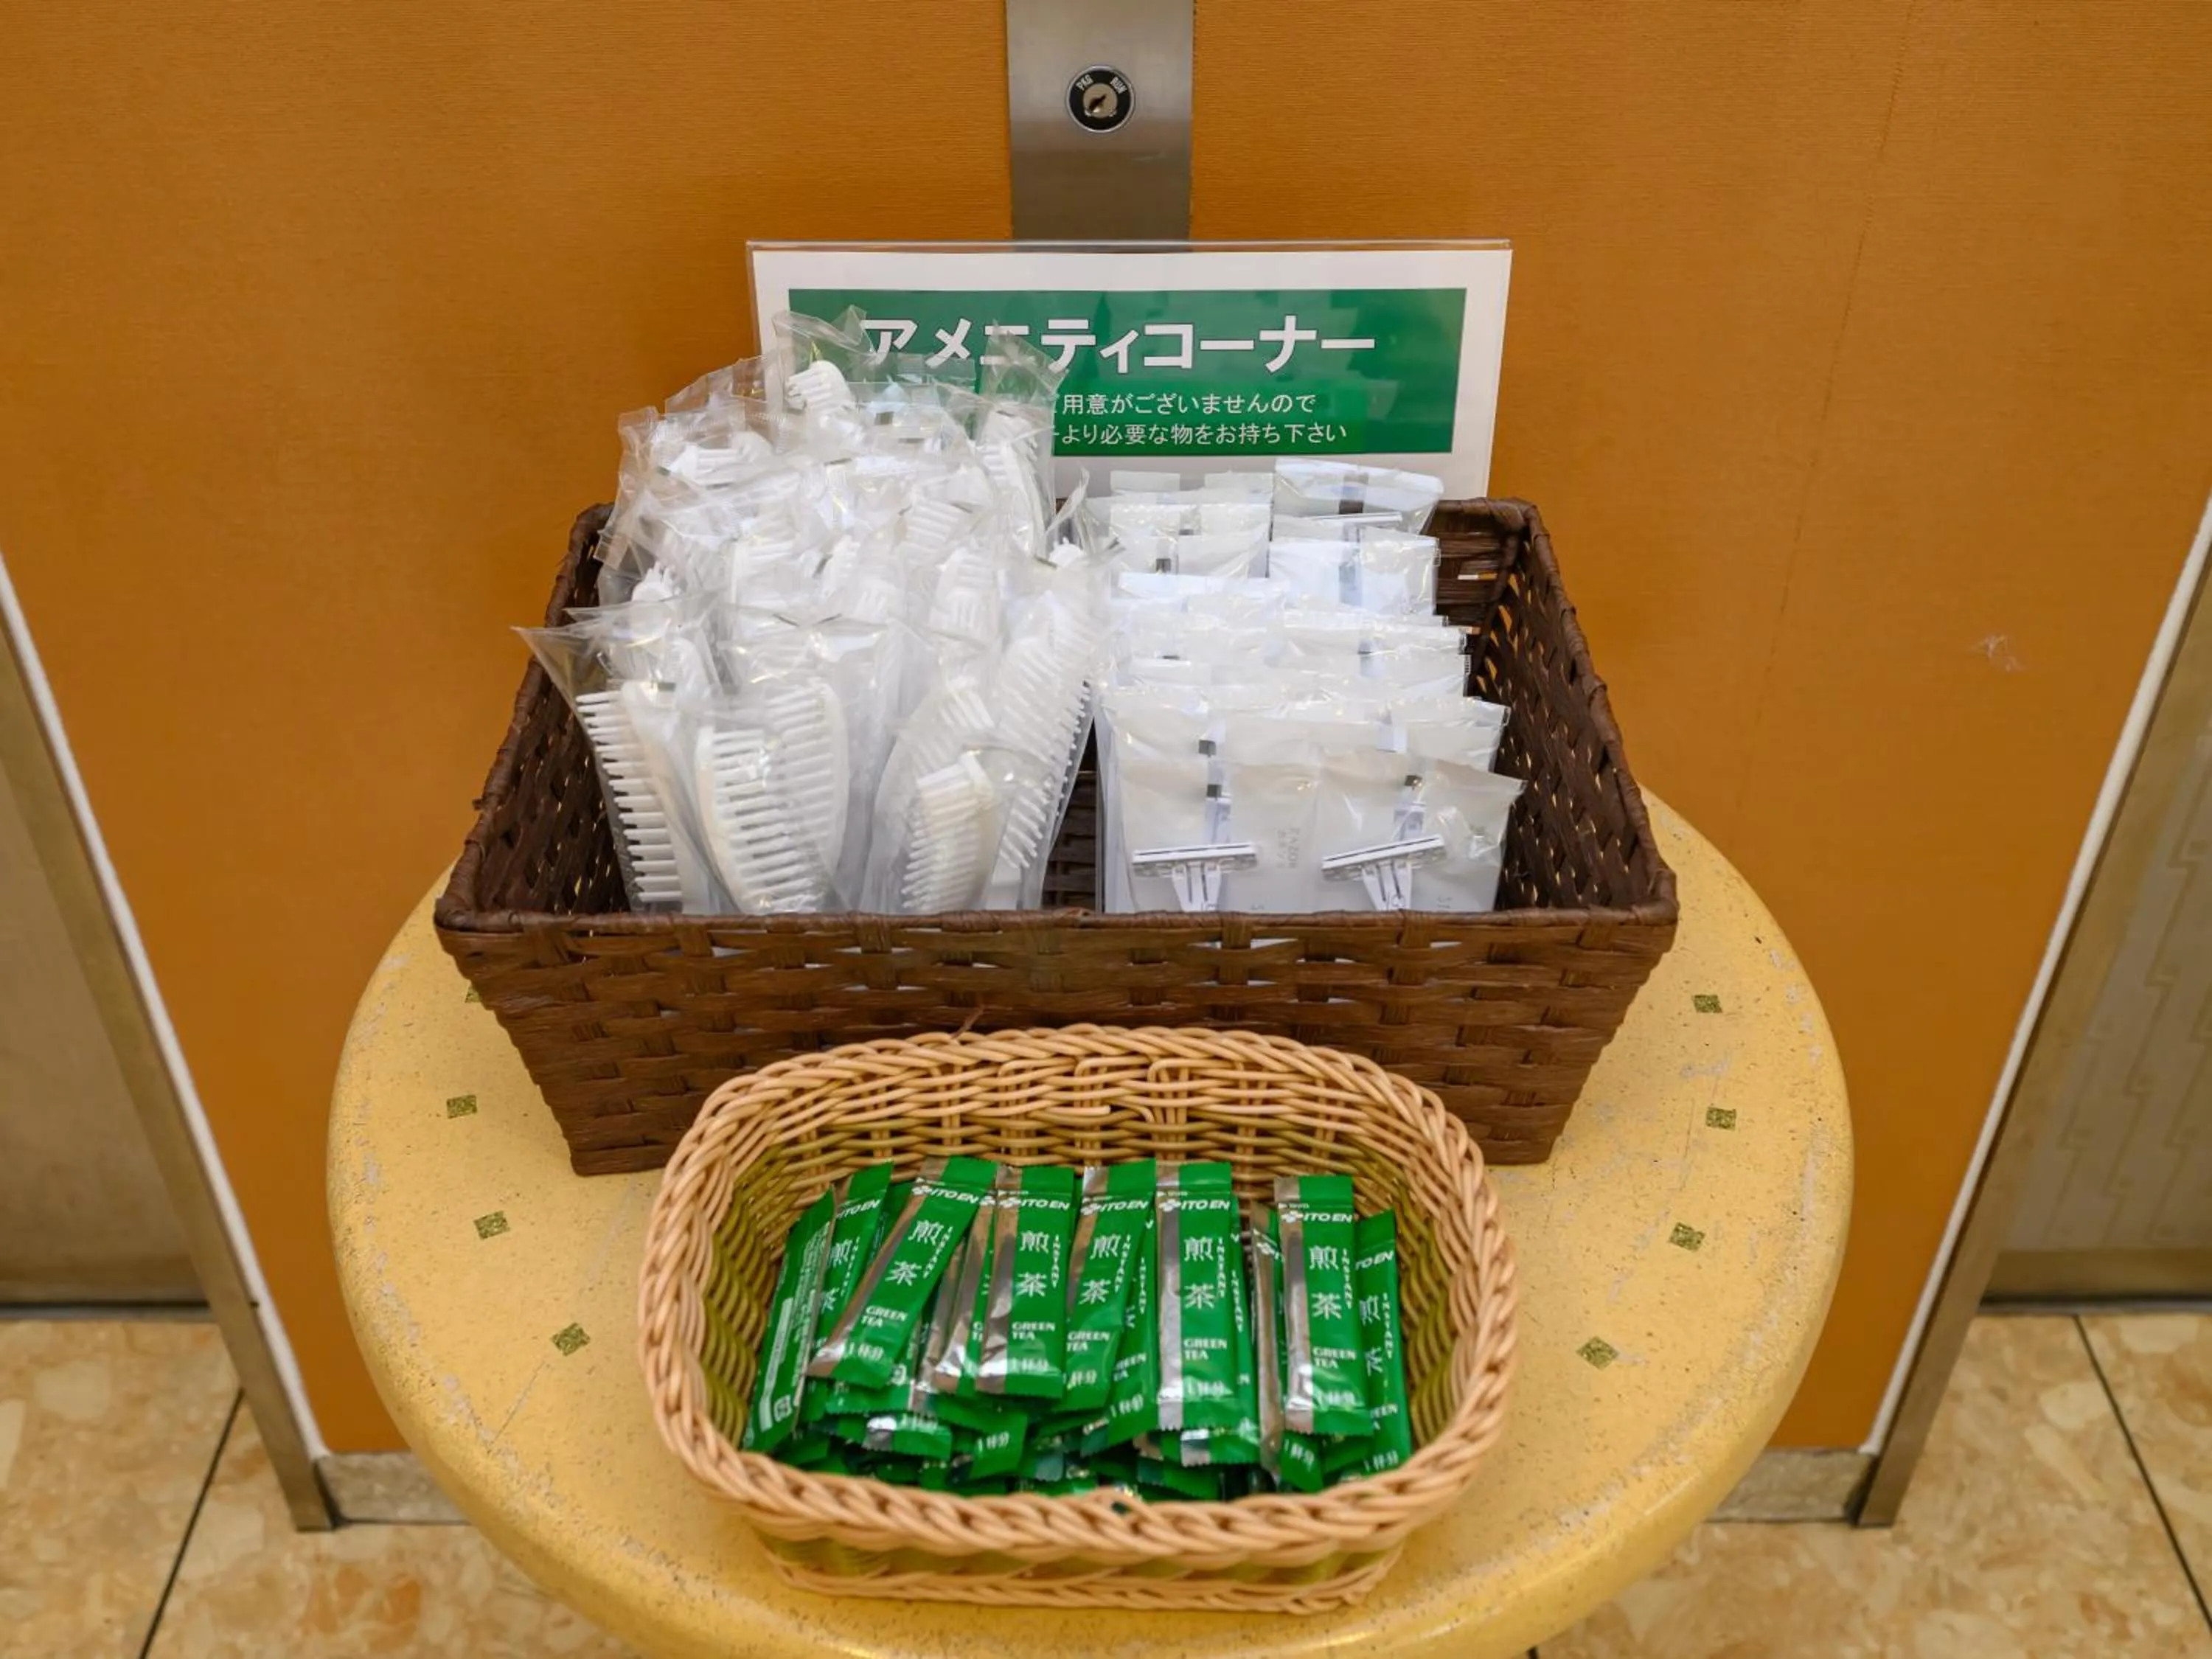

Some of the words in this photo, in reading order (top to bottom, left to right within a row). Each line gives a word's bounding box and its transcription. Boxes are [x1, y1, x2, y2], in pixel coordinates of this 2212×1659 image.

[859, 314, 1377, 374] アメニティコーナー
[1053, 393, 1317, 415] 用意がございませんので
[1053, 422, 1347, 445] より必要な物をお持ち下さい
[1354, 1256, 1373, 1270] TO
[866, 1305, 908, 1322] GREEN
[861, 1315, 883, 1328] TEA
[1012, 1321, 1055, 1332] GREEN
[1012, 1331, 1035, 1340] TEA
[1068, 1331, 1110, 1341] GREEN
[1066, 1341, 1088, 1352] TEA
[1183, 1338, 1228, 1349] GREEN
[1184, 1349, 1209, 1361] TEA
[1312, 1347, 1357, 1361] GREEN
[1314, 1357, 1339, 1369] TEA
